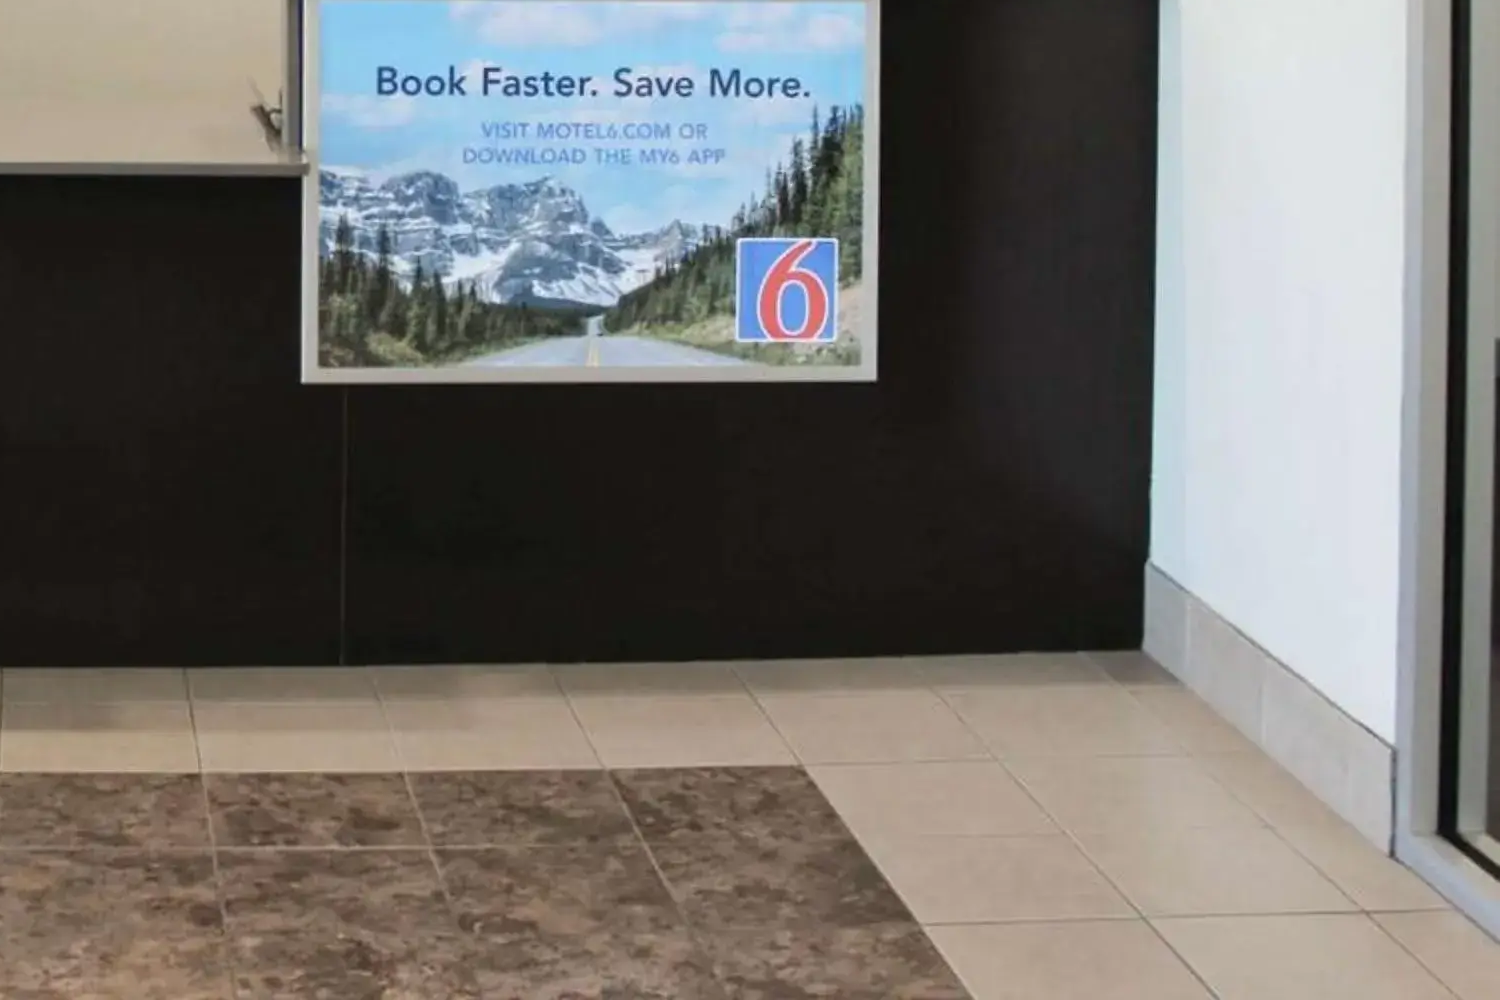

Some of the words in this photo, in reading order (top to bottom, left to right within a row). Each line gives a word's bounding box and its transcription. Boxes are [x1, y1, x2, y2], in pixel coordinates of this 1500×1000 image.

[375, 64, 467, 97] Book
[481, 66, 598, 98] Faster.
[613, 68, 695, 98] Save
[709, 69, 810, 99] More.
[480, 121, 530, 141] VISIT
[536, 121, 671, 142] MOTEL6.COM
[679, 122, 708, 141] OR
[462, 146, 587, 166] DOWNLOAD
[594, 147, 632, 166] THE
[640, 147, 680, 166] MY6
[687, 147, 726, 166] APP
[757, 239, 828, 341] 6
